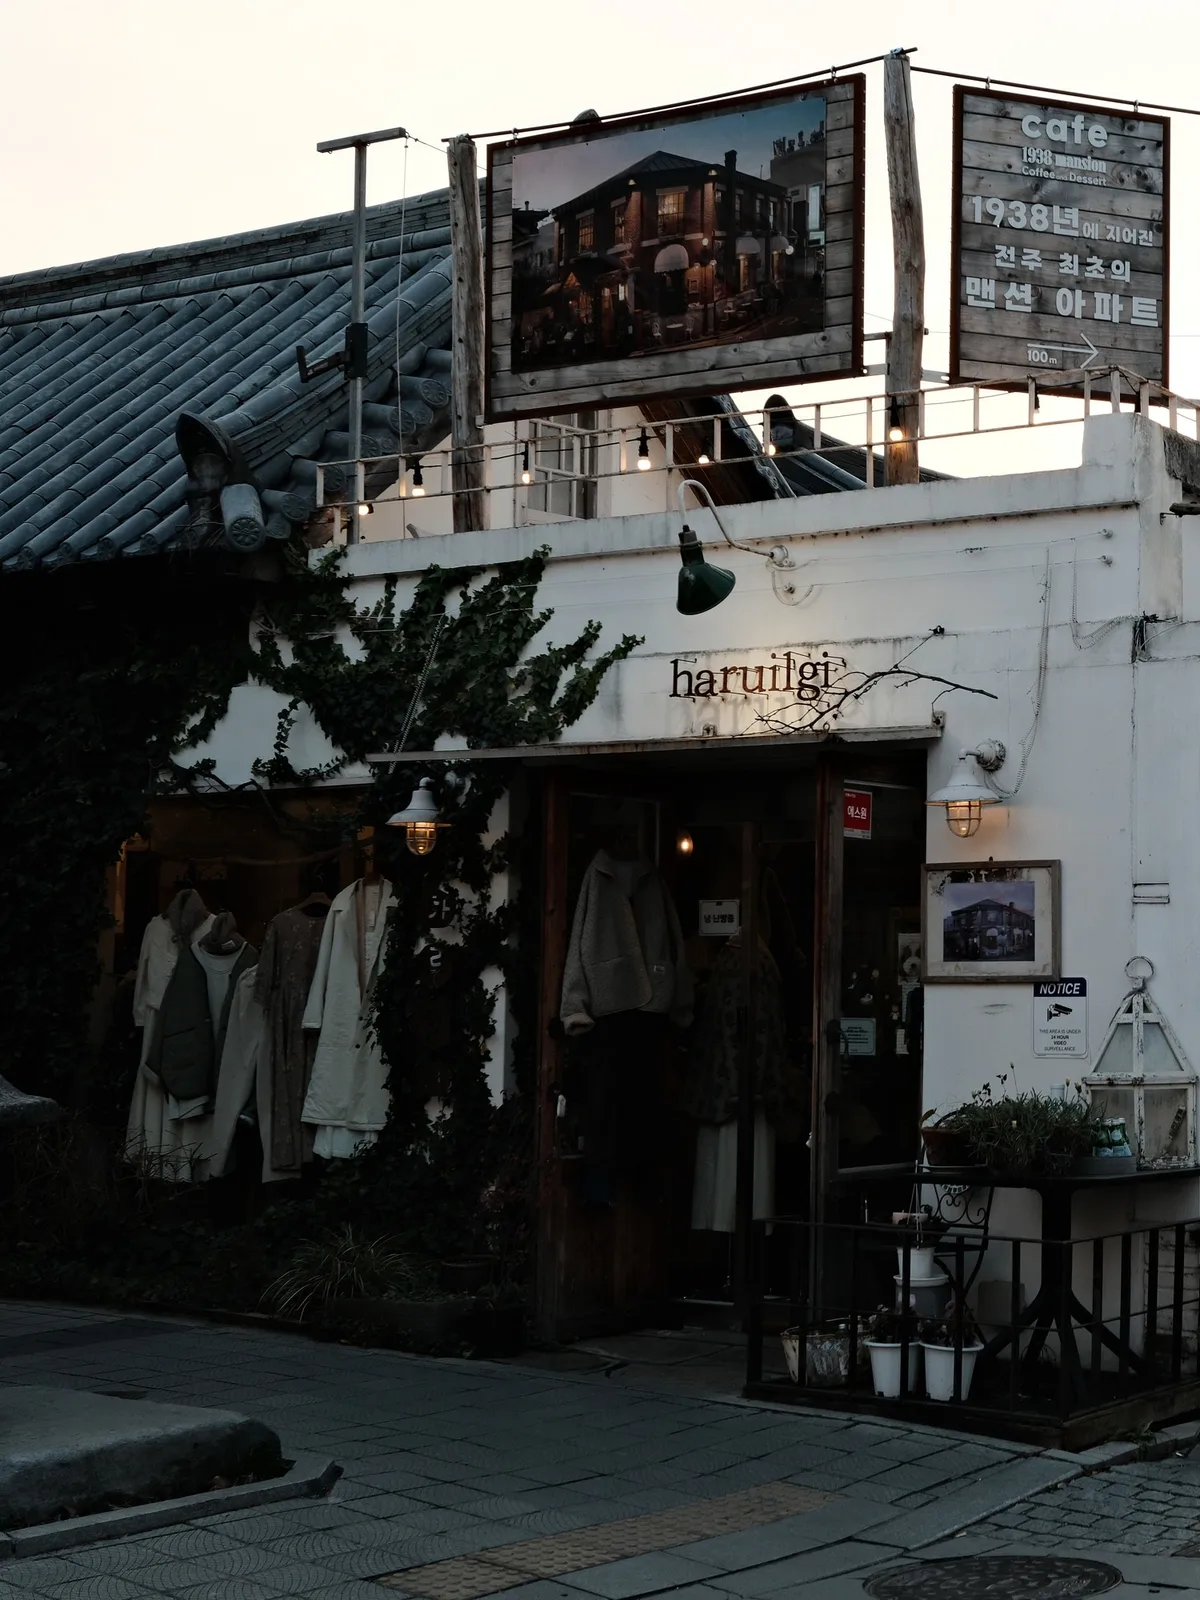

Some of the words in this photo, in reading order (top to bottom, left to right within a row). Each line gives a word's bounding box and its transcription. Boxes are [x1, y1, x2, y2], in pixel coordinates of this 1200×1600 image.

[1021, 114, 1108, 148] cafe
[1021, 146, 1052, 165] 1938
[1055, 154, 1107, 173] mansion
[1022, 166, 1055, 179] Coffee
[1069, 172, 1107, 186] Dessert
[1106, 224, 1153, 247] 지어진
[995, 245, 1042, 270] 전주
[1059, 253, 1131, 283] 최초의
[966, 277, 1032, 313] 맨션
[1055, 287, 1159, 327] 아파트
[669, 651, 831, 700] haruilgi
[847, 805, 867, 820] 에스원
[1039, 983, 1080, 994] NOTICE
